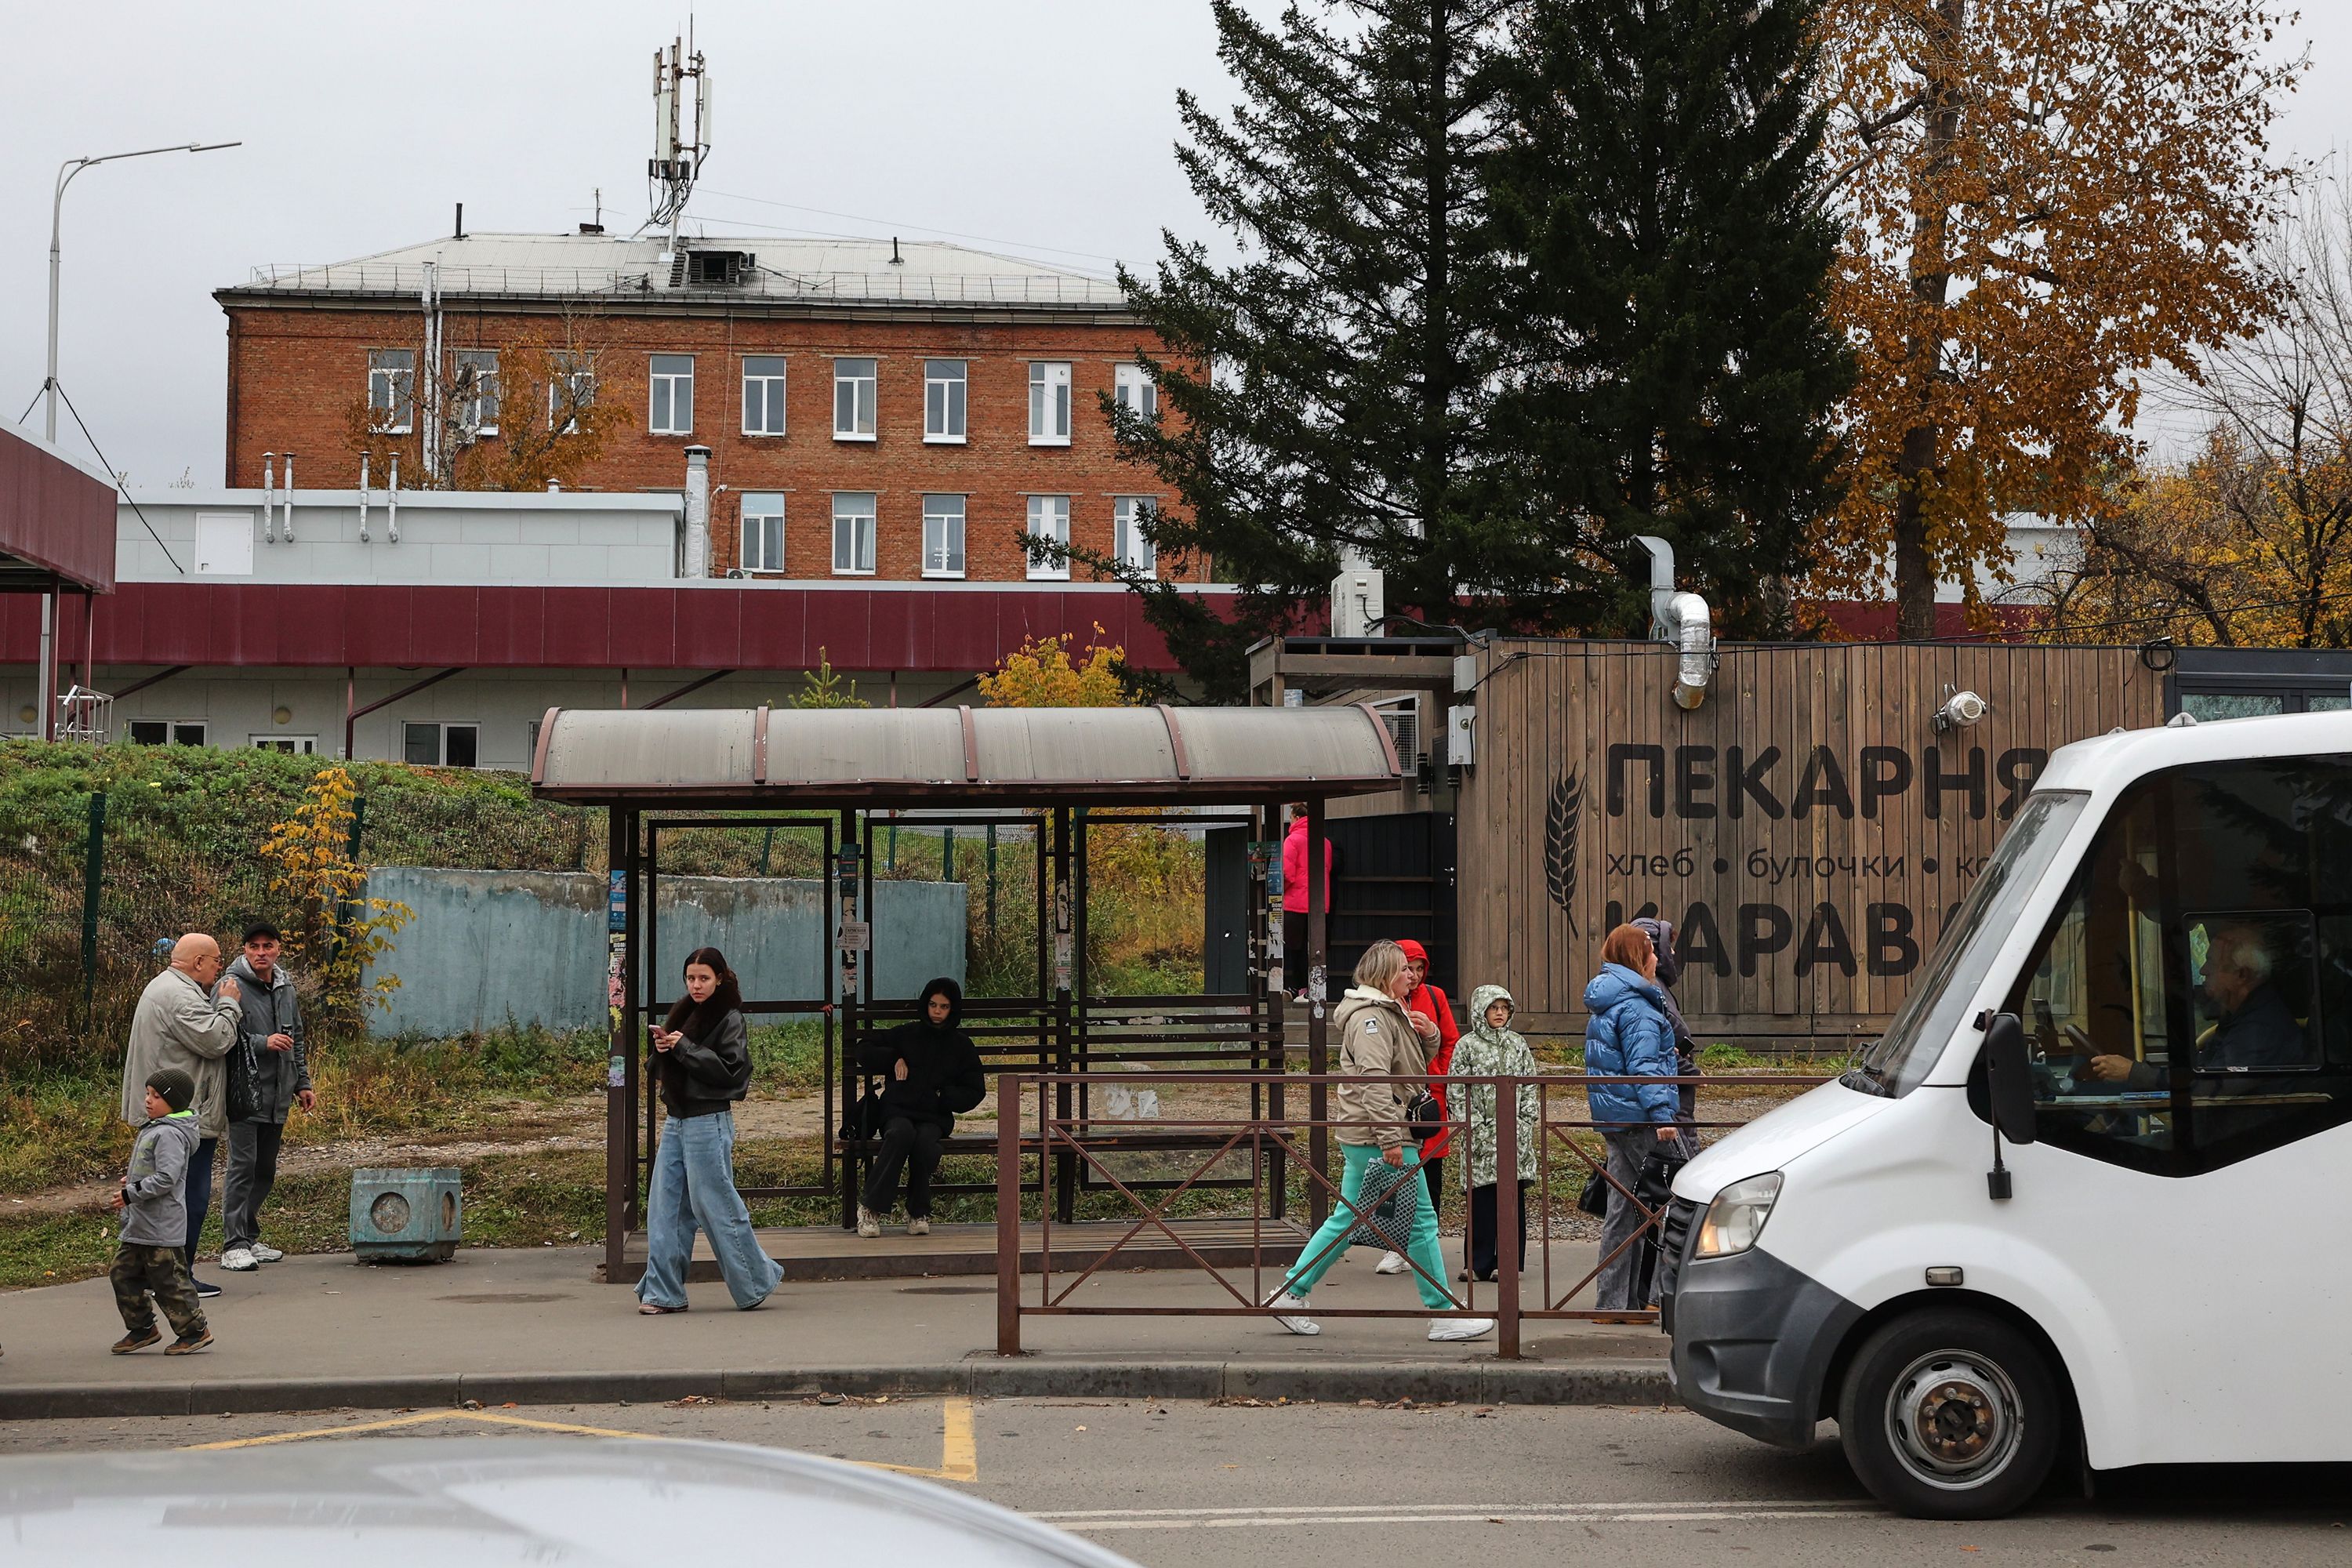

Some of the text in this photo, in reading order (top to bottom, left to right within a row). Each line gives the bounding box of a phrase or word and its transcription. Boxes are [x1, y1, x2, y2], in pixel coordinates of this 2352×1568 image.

[1608, 743, 2049, 820] ПЕКАРНЯ
[1607, 848, 1695, 878] хлеб
[1748, 848, 1905, 885] булочки
[1607, 901, 1963, 978] АРАВ
